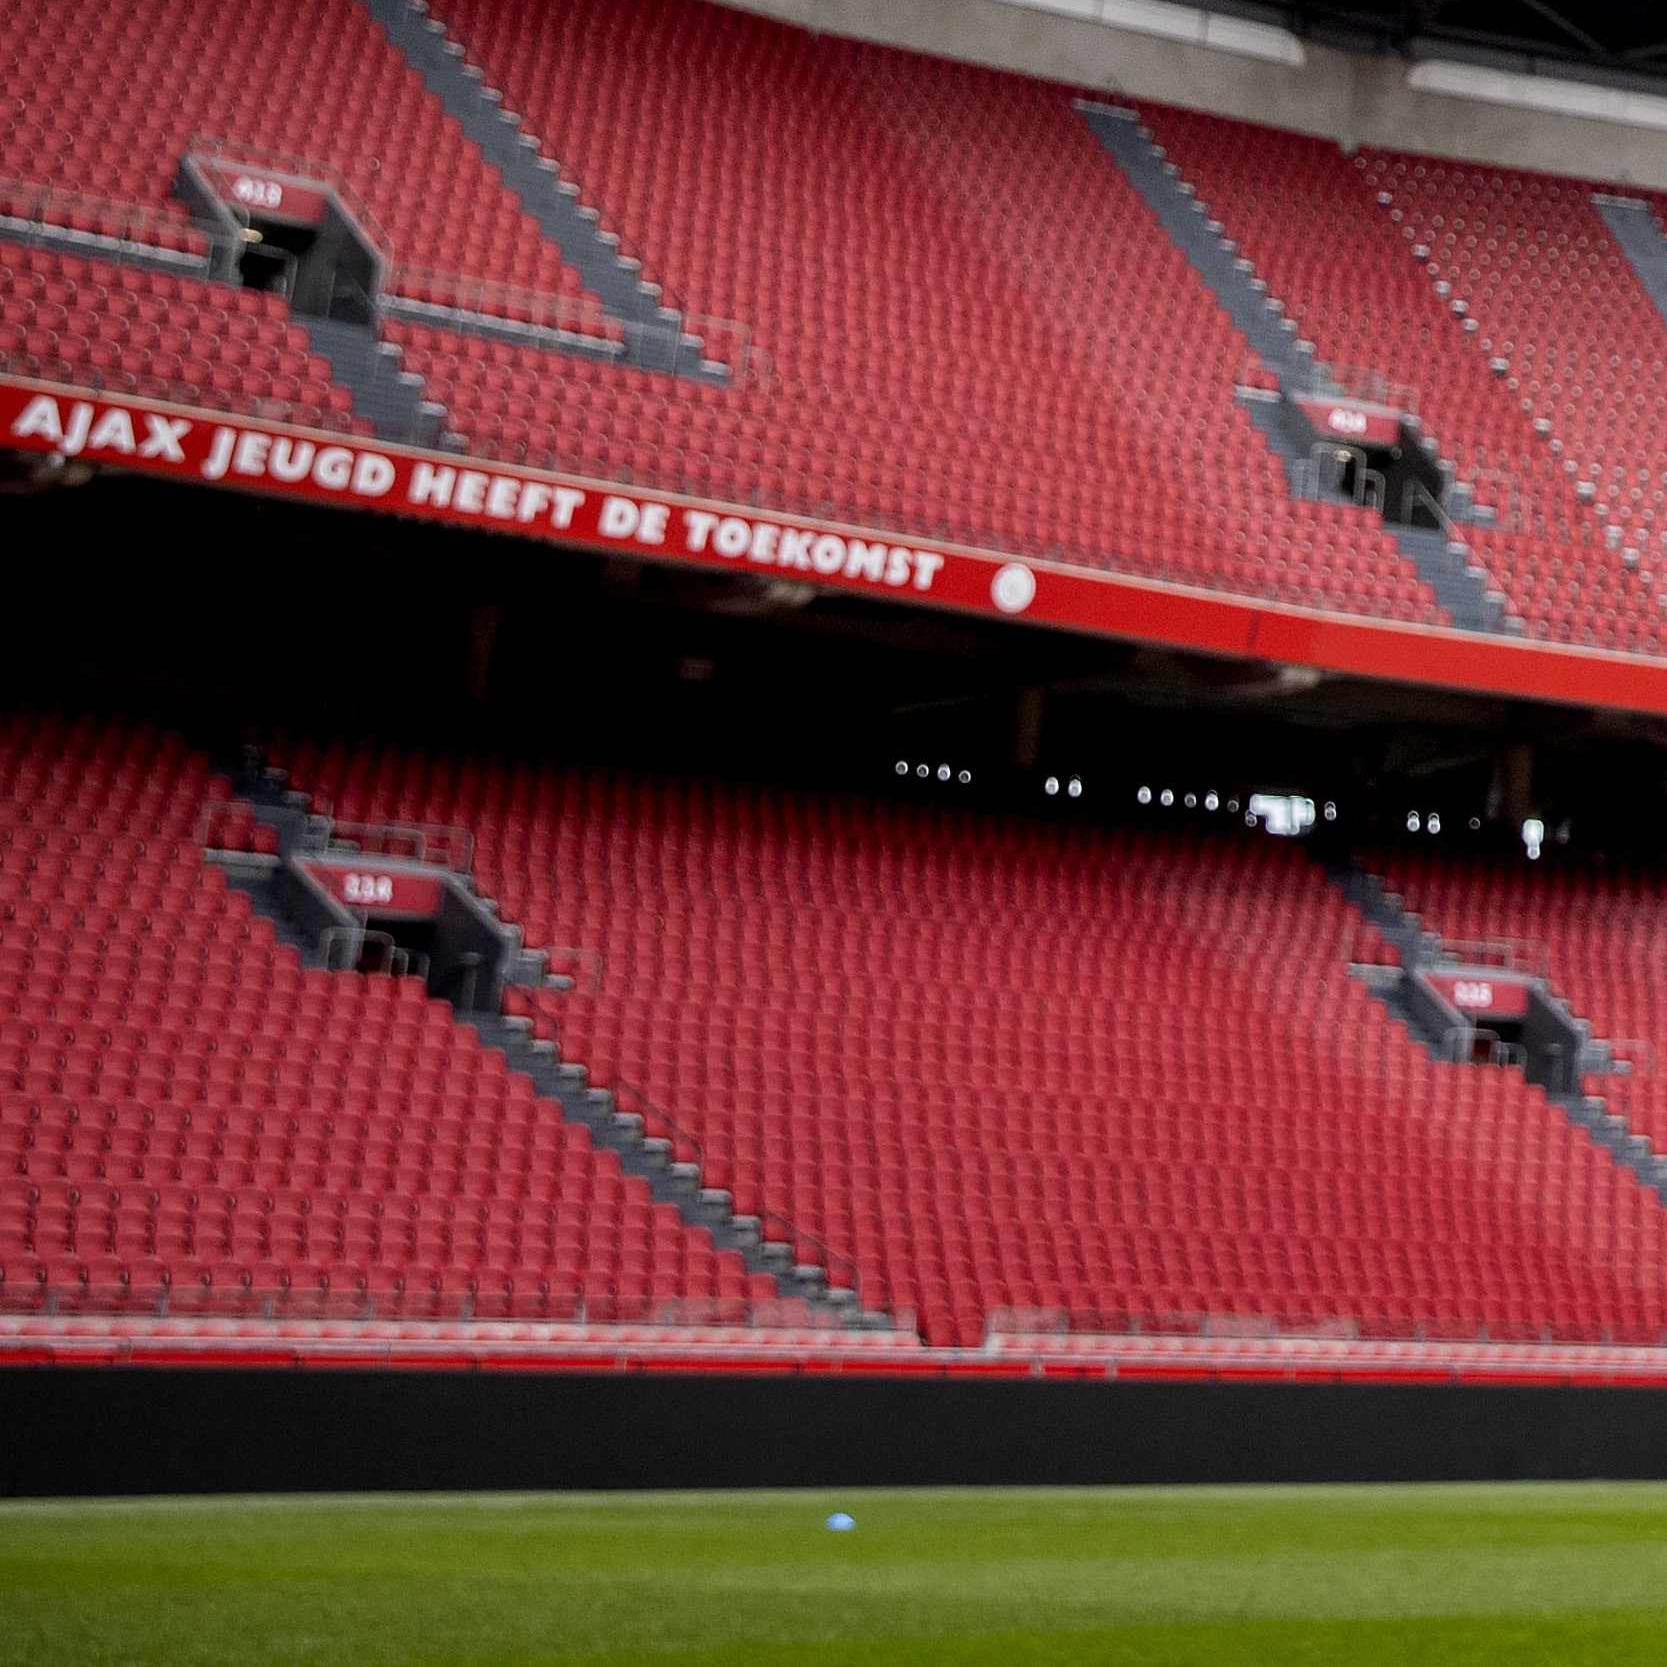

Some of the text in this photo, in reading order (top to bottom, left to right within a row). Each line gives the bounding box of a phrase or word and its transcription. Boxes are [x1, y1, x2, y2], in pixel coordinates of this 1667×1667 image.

[11, 394, 945, 591] AJAX JEUGD HEEFT DE TOEKOMST
